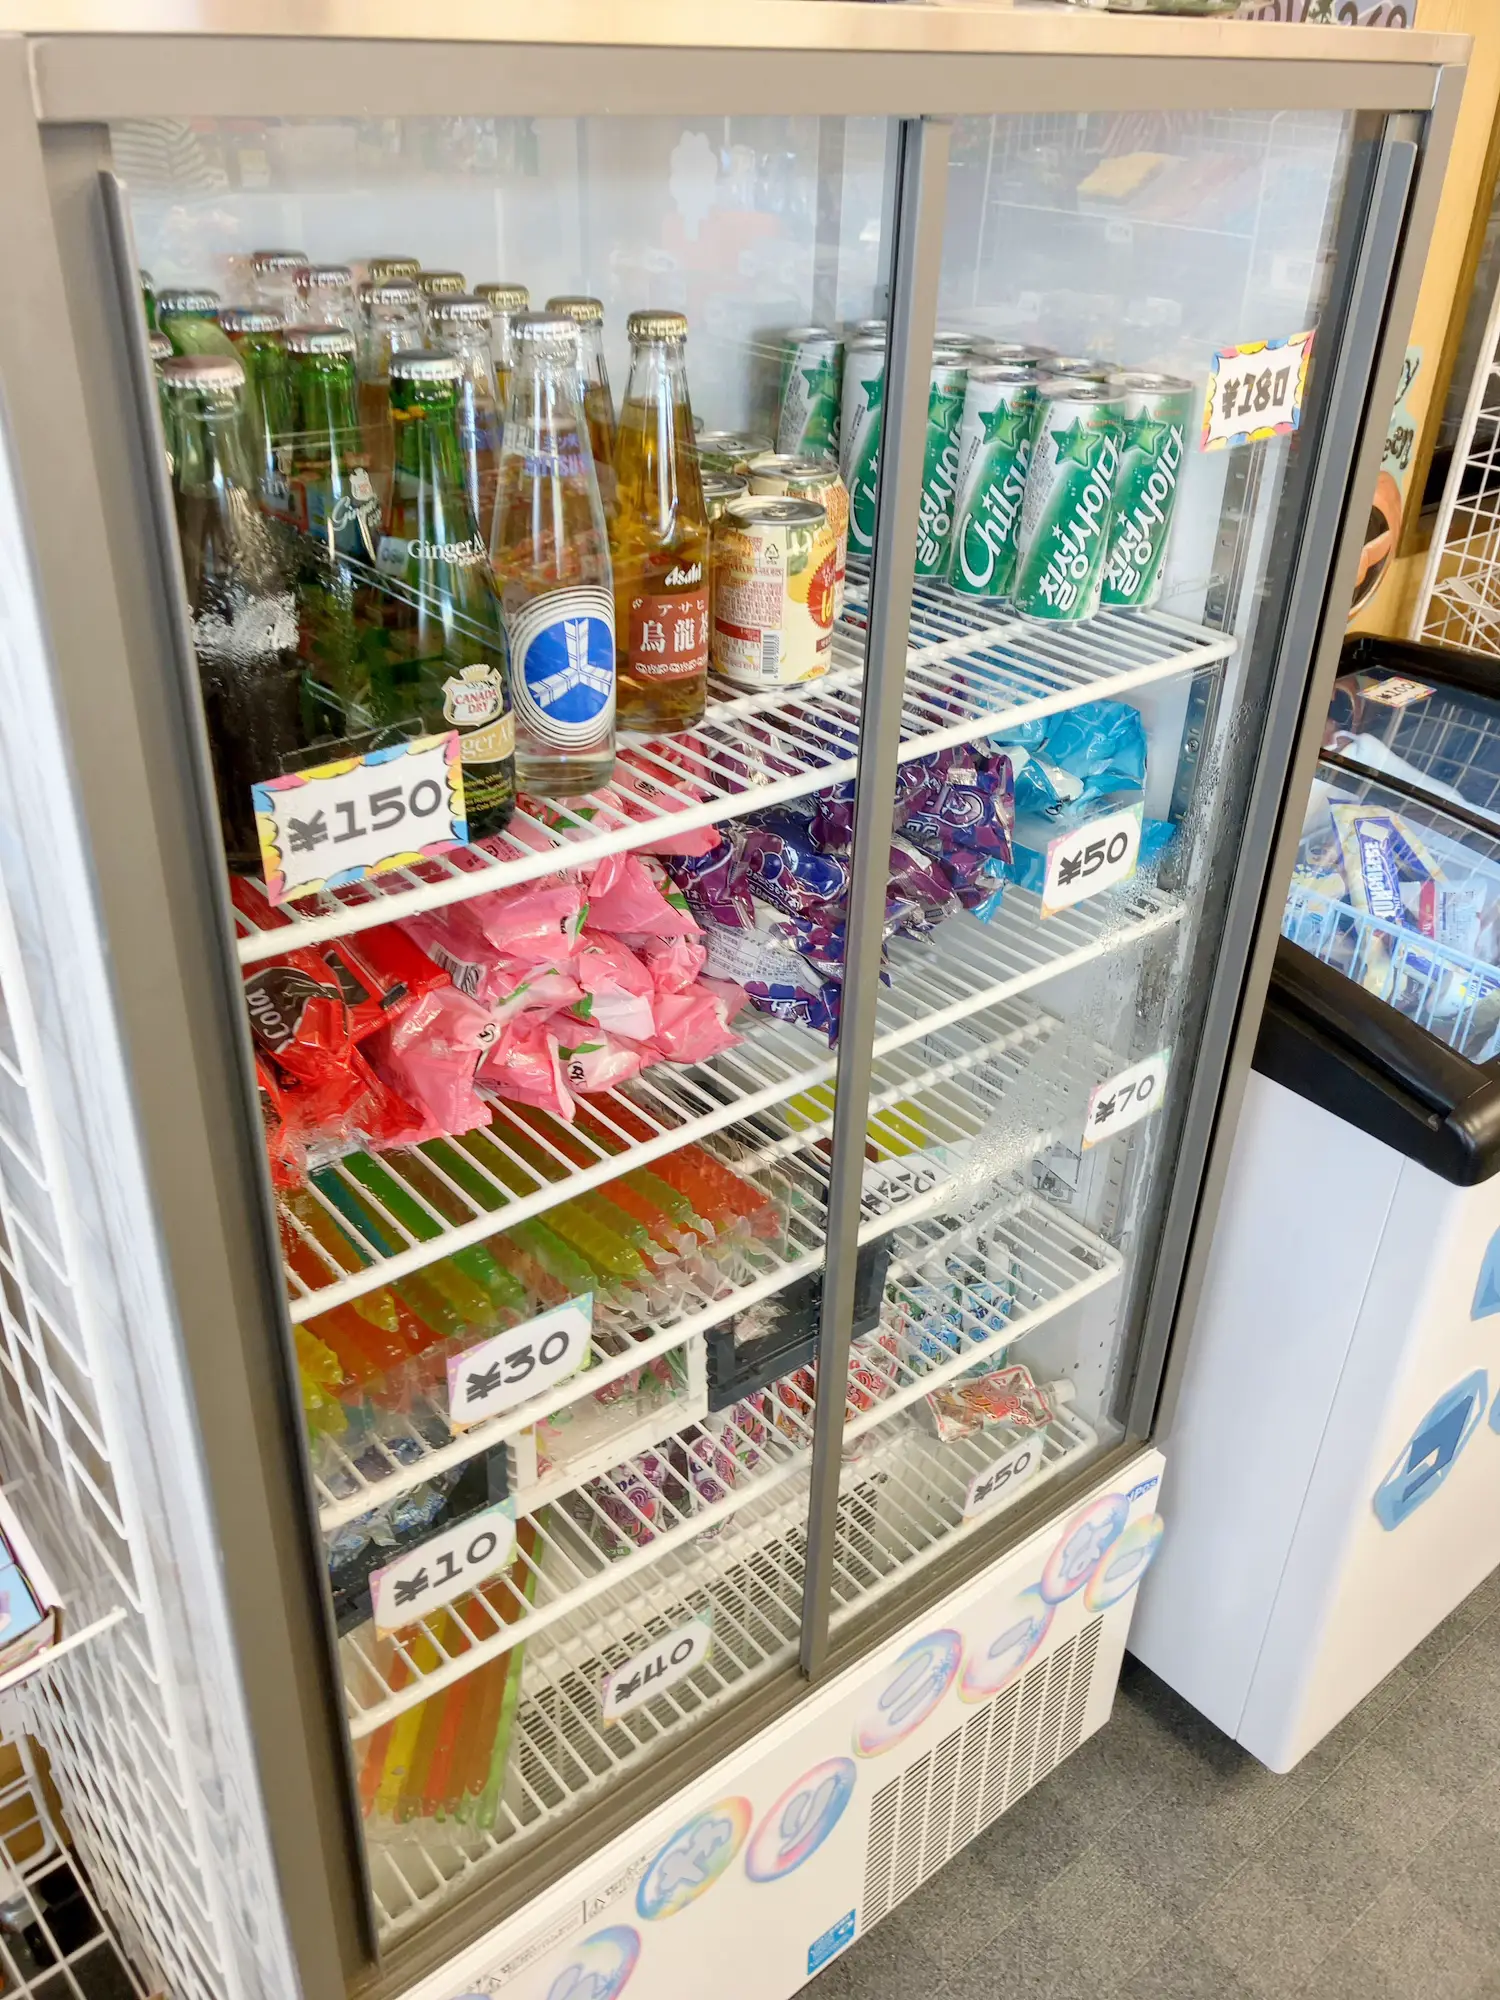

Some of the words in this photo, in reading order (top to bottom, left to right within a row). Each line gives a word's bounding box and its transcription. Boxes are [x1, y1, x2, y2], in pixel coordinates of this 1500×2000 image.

[1221, 365, 1292, 420] ¥180
[1038, 433, 1121, 612] 칠성사이다
[407, 538, 473, 564] Ginger
[664, 561, 702, 587] Asahi
[657, 599, 705, 617] アサヒ
[467, 702, 489, 714] DRY
[461, 733, 497, 761] ger
[287, 779, 443, 853] ¥150
[1057, 831, 1129, 887] ¥50
[1094, 1074, 1155, 1126] ¥70
[466, 1331, 569, 1403] ¥30
[973, 1452, 1031, 1504] ¥50
[393, 1532, 497, 1607] ¥10
[615, 1638, 694, 1704] ¥40
